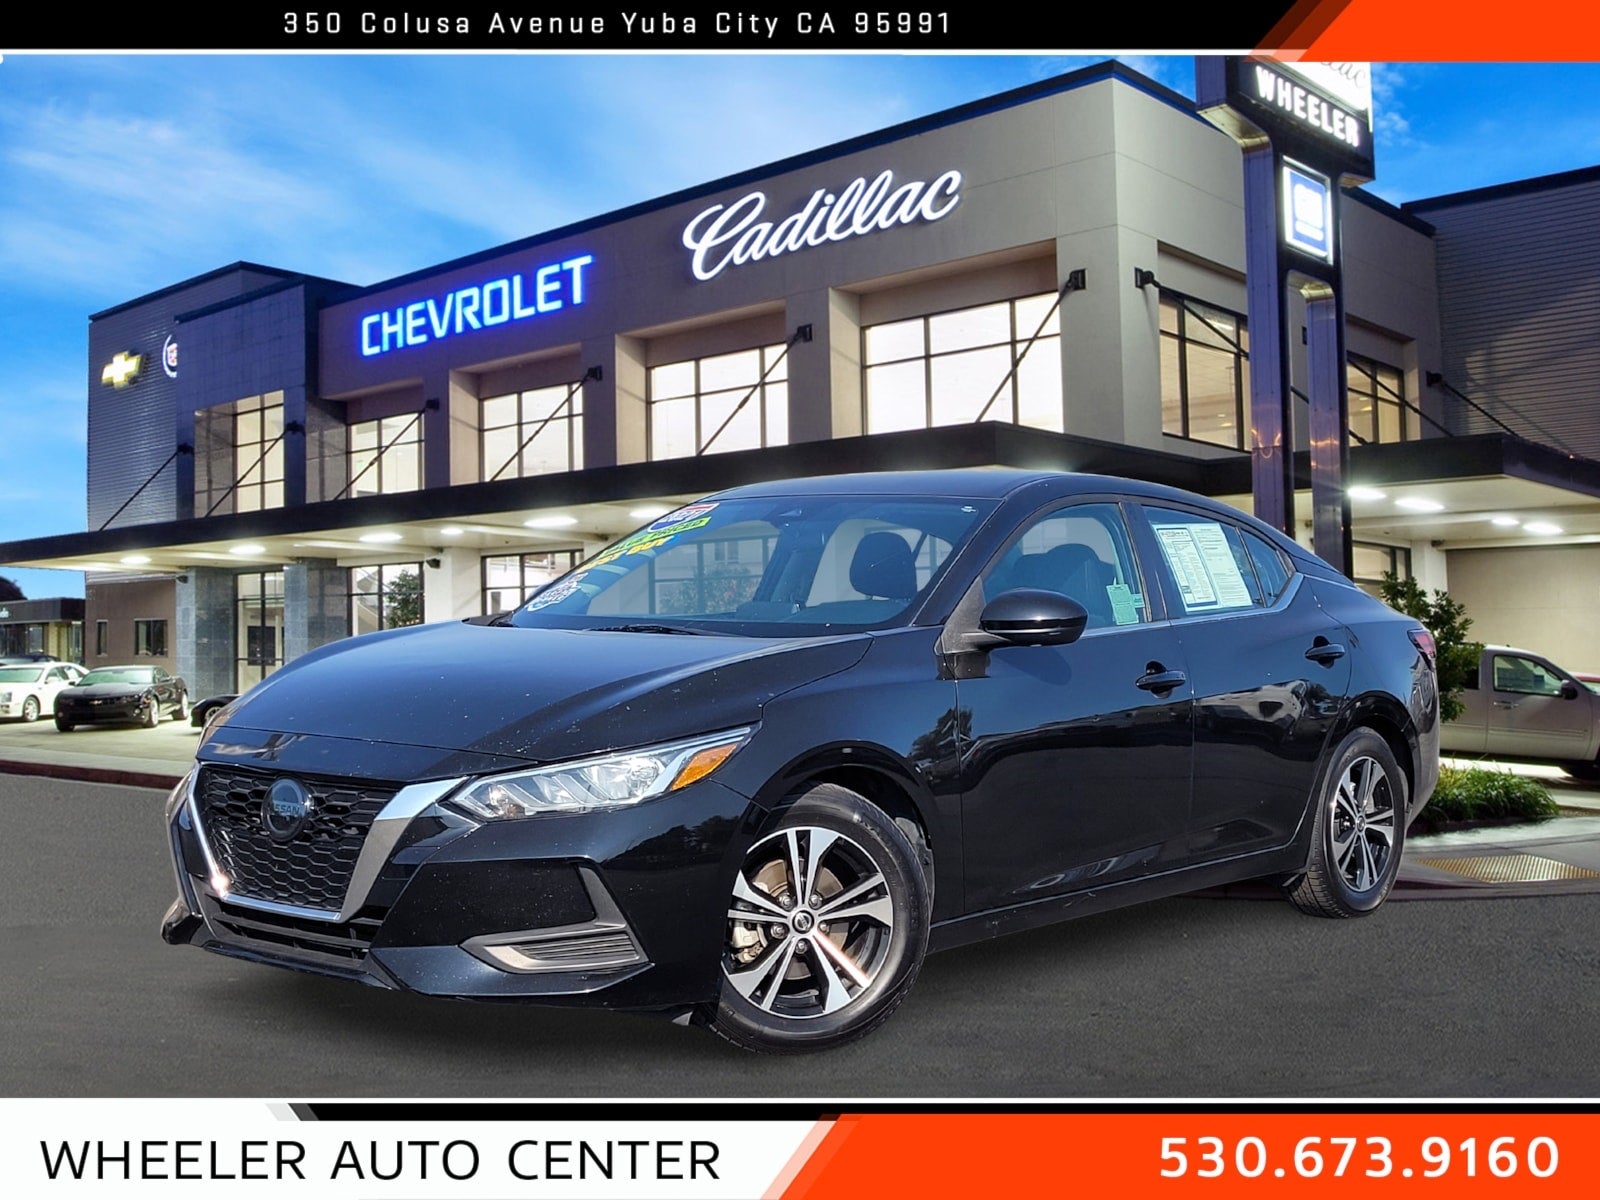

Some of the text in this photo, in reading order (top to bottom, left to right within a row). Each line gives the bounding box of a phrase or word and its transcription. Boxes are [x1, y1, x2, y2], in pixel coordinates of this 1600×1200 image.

[1256, 65, 1360, 148] WHEELER
[682, 169, 962, 281] Cadillac
[361, 254, 593, 357] CHEVROLET
